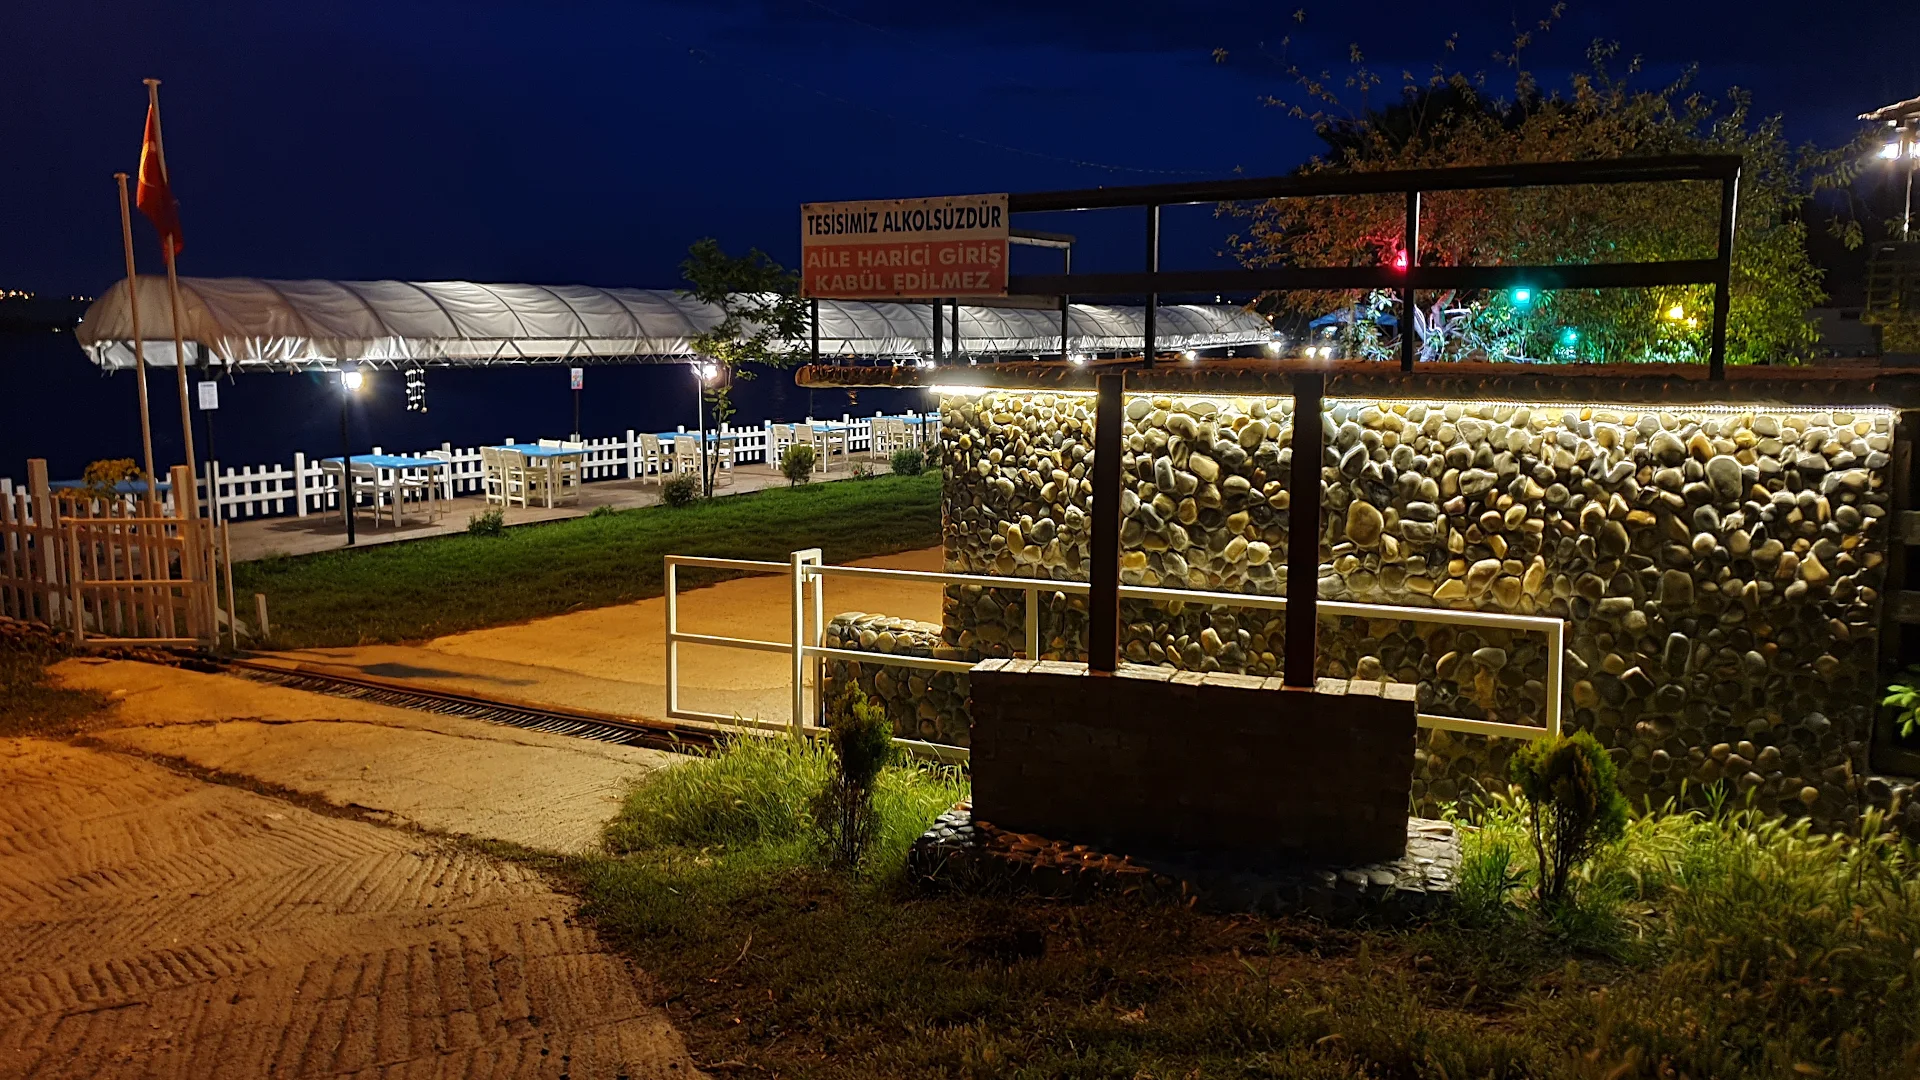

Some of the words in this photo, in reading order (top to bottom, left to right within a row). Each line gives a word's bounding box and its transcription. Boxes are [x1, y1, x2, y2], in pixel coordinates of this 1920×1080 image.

[807, 207, 878, 235] TESİSİMİZ
[882, 201, 1001, 232] ALKOLSÜZDÜR
[807, 248, 851, 268] AİLE
[858, 245, 930, 267] HARİCİ
[938, 242, 1002, 269] GİRİŞ
[815, 270, 886, 291] KABÜL
[893, 268, 990, 290] EDİLMEZ
